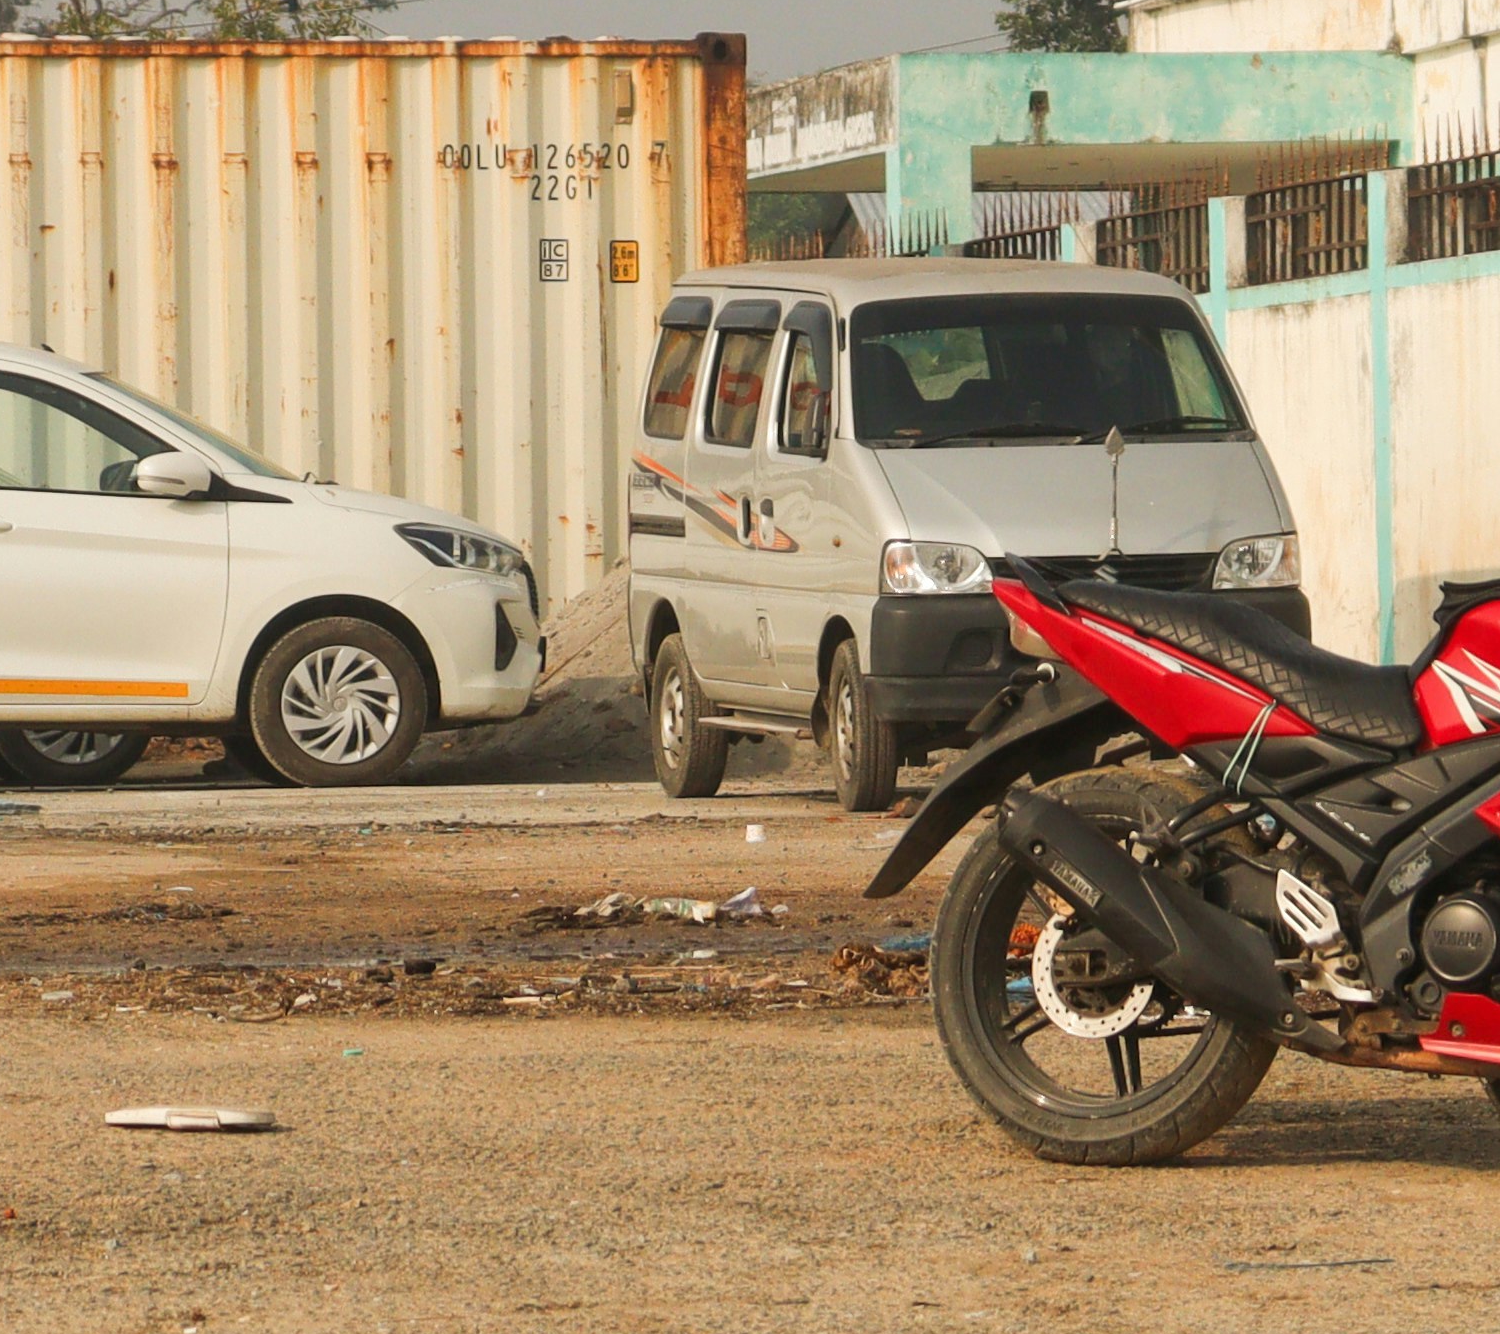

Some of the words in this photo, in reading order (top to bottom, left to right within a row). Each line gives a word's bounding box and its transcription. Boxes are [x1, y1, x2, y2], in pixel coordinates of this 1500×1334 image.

[442, 143, 507, 170] OOLU
[532, 143, 630, 170] 126520
[653, 142, 665, 168] 7
[544, 264, 563, 278] 87
[1049, 860, 1093, 901] YAMAHA
[1433, 930, 1483, 947] YAMAHA
